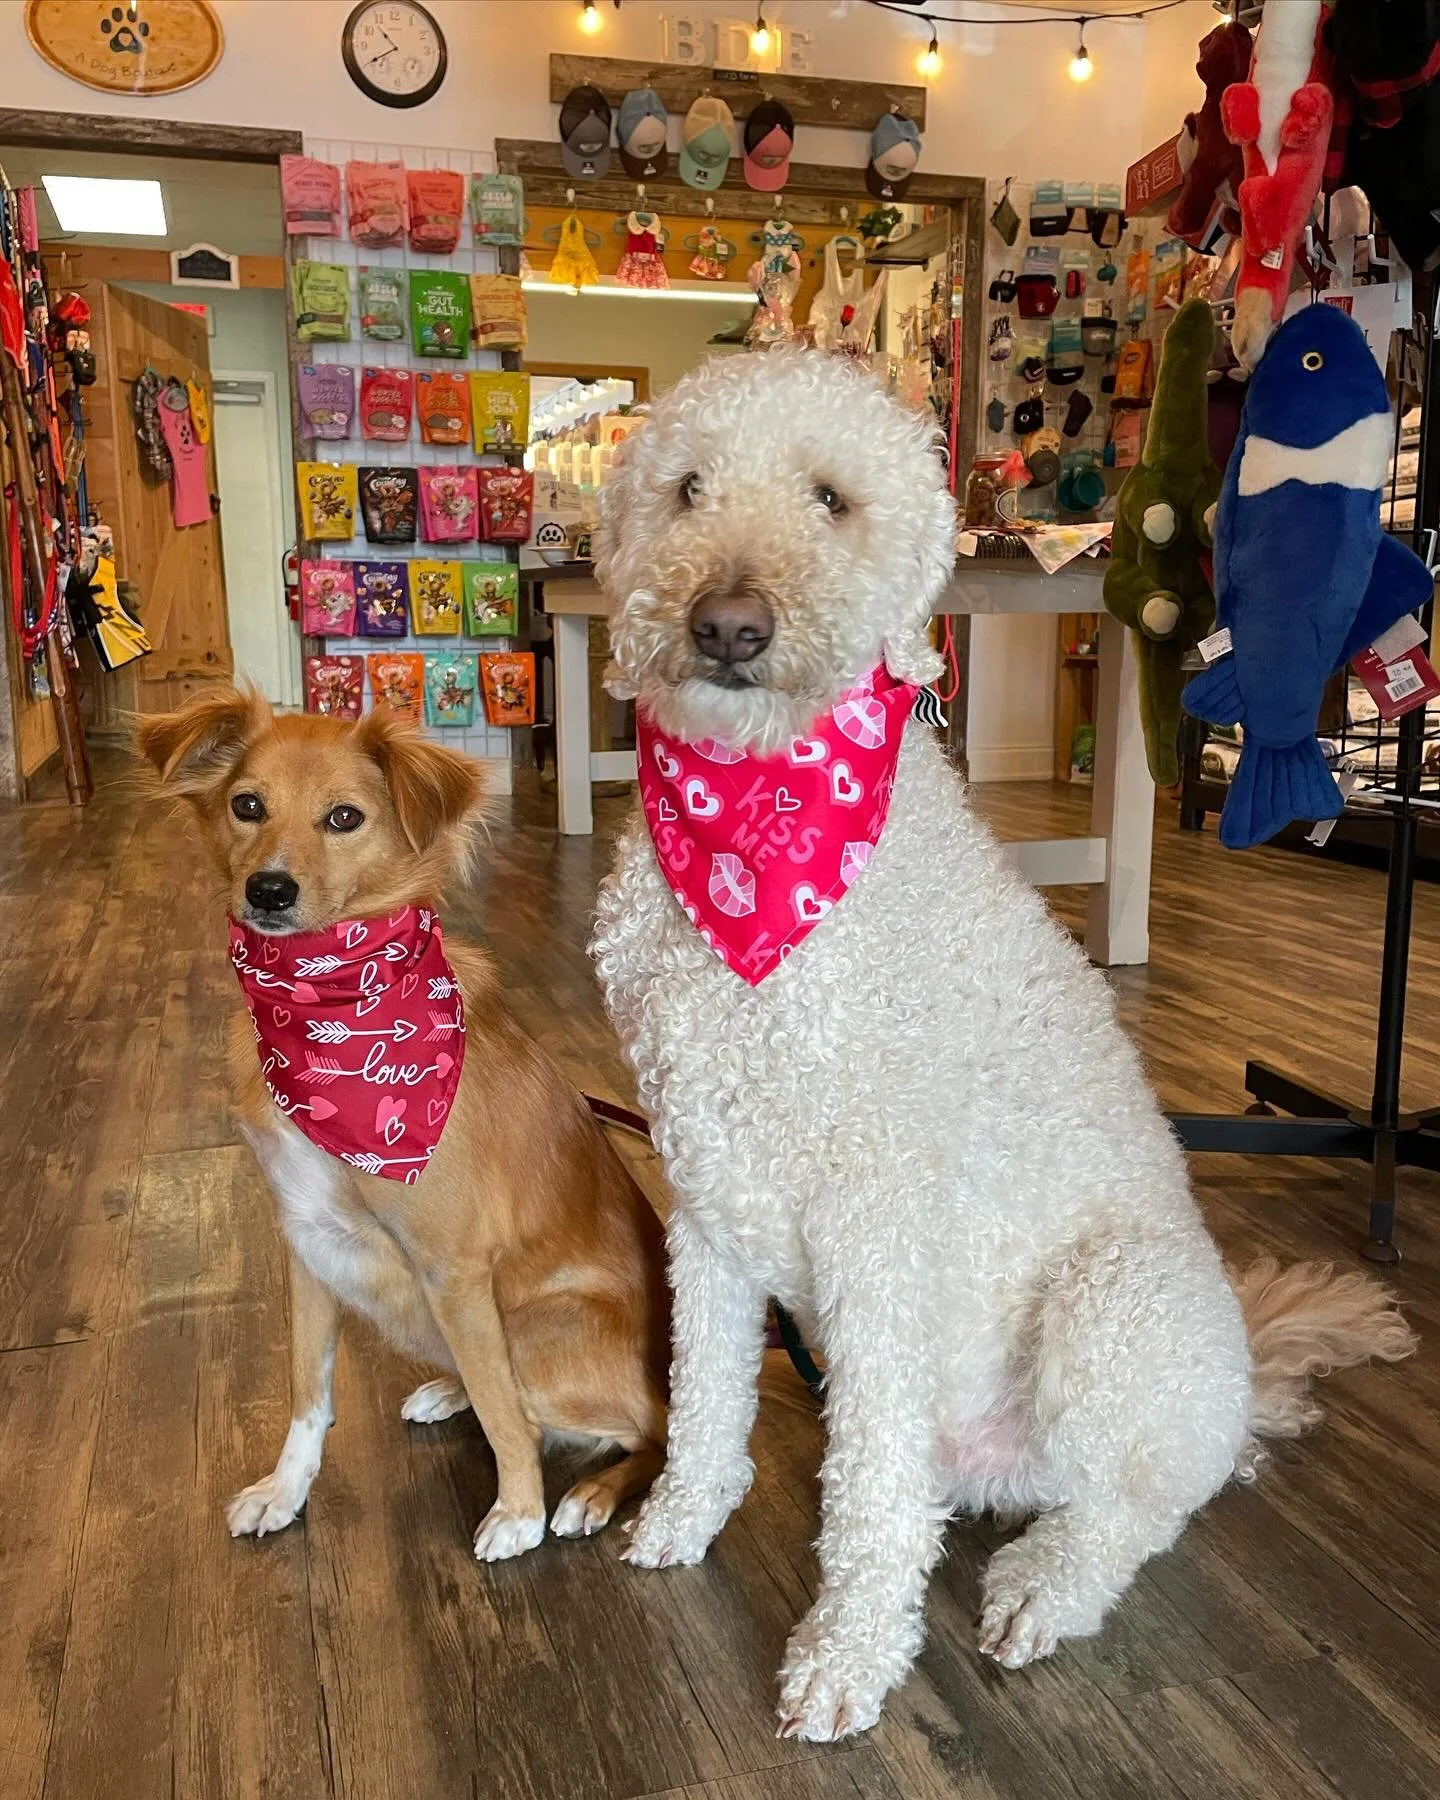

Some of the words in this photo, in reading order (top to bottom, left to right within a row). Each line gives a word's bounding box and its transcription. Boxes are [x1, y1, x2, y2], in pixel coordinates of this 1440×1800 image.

[374, 12, 383, 25] 11
[389, 8, 401, 21] 12
[90, 59, 117, 80] Dog
[428, 295, 454, 306] GUT
[417, 304, 464, 317] HEALTH
[736, 775, 823, 864] KISS
[730, 822, 779, 872] ME
[361, 1041, 424, 1085] love
